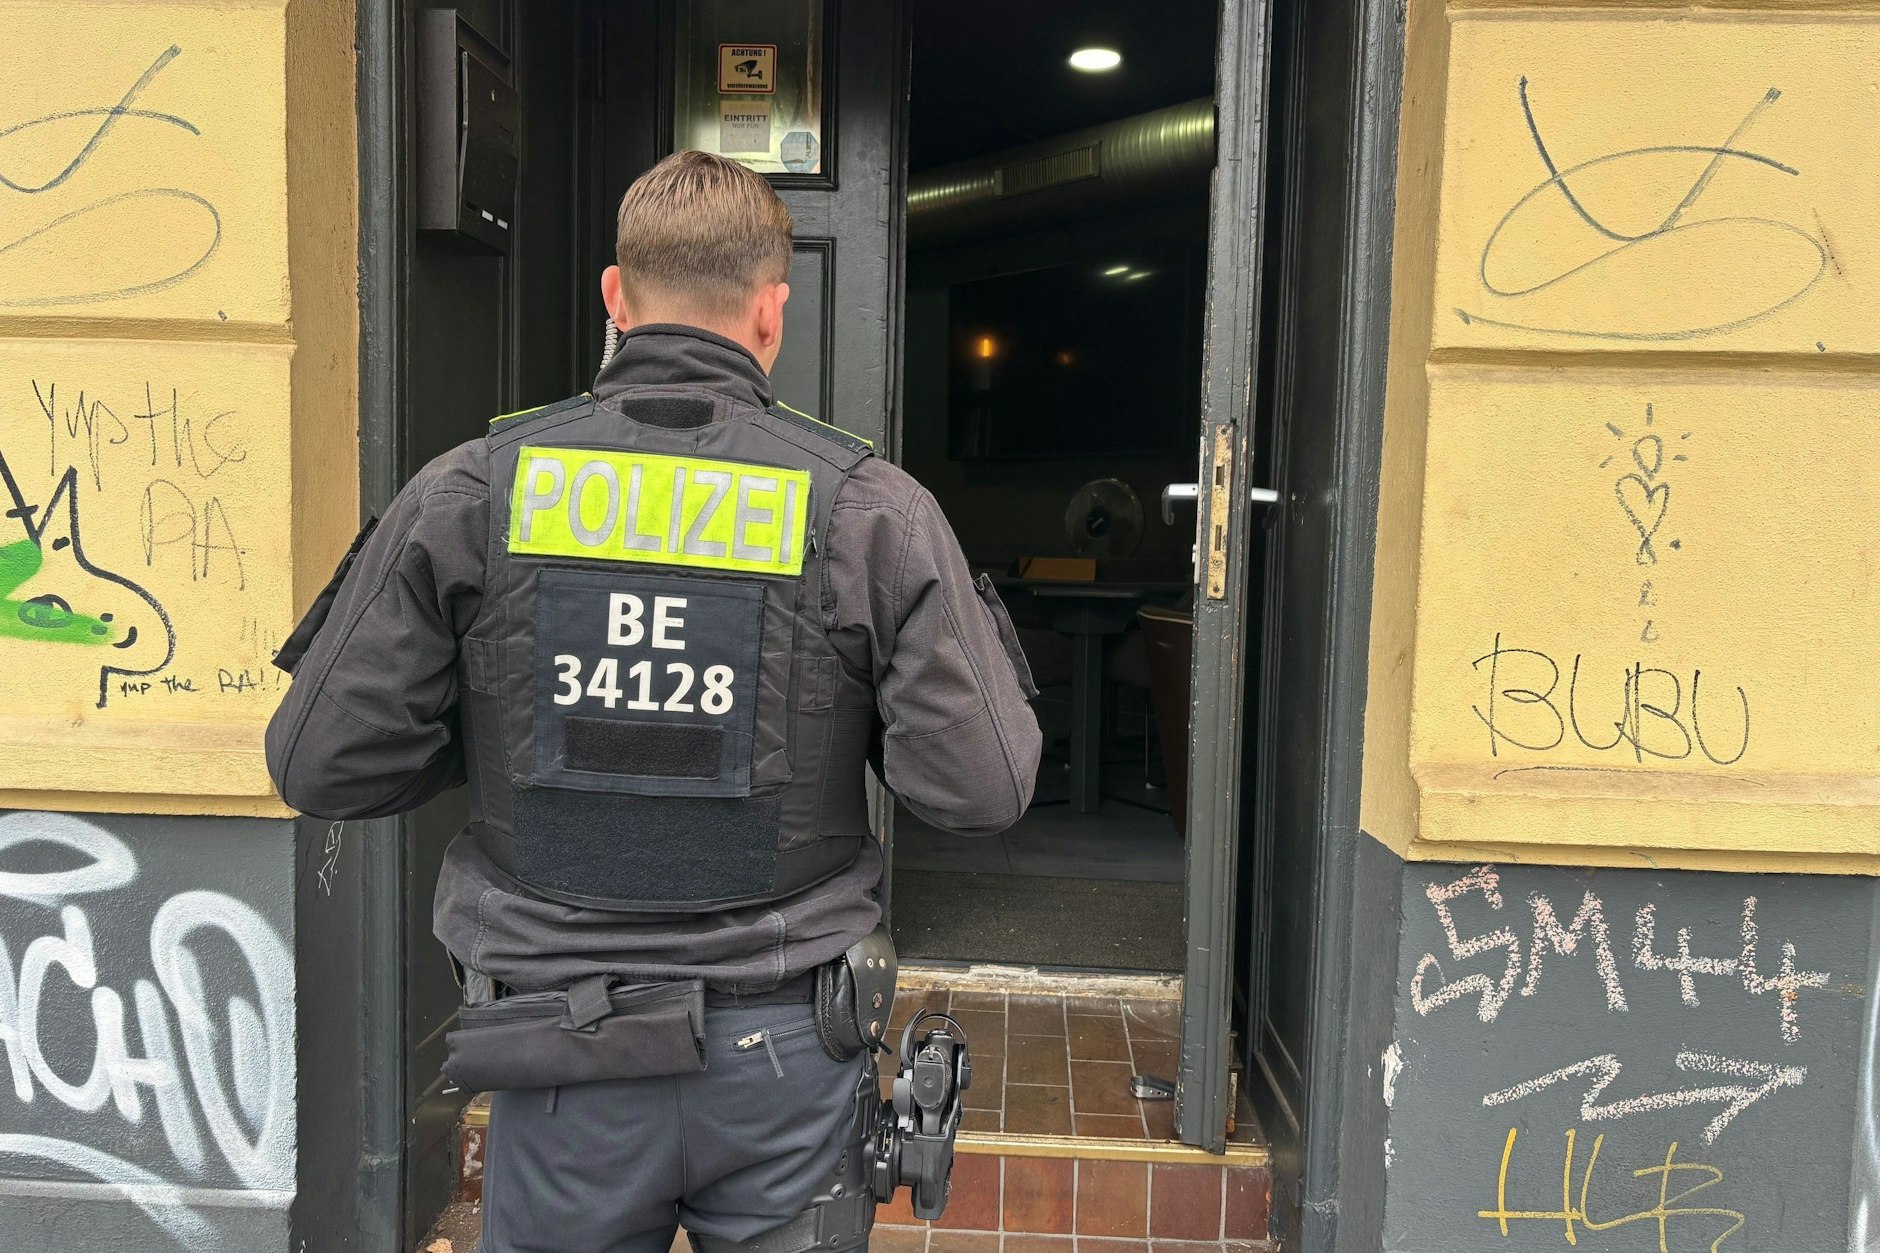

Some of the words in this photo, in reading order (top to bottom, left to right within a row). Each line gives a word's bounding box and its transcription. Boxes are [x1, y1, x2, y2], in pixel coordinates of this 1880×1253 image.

[724, 114, 768, 122] EINTRITT
[520, 456, 798, 564] POLIZEI
[607, 592, 688, 650] BE
[160, 675, 200, 694] the
[553, 654, 735, 716] 34128
[1471, 632, 1750, 766] BUBU
